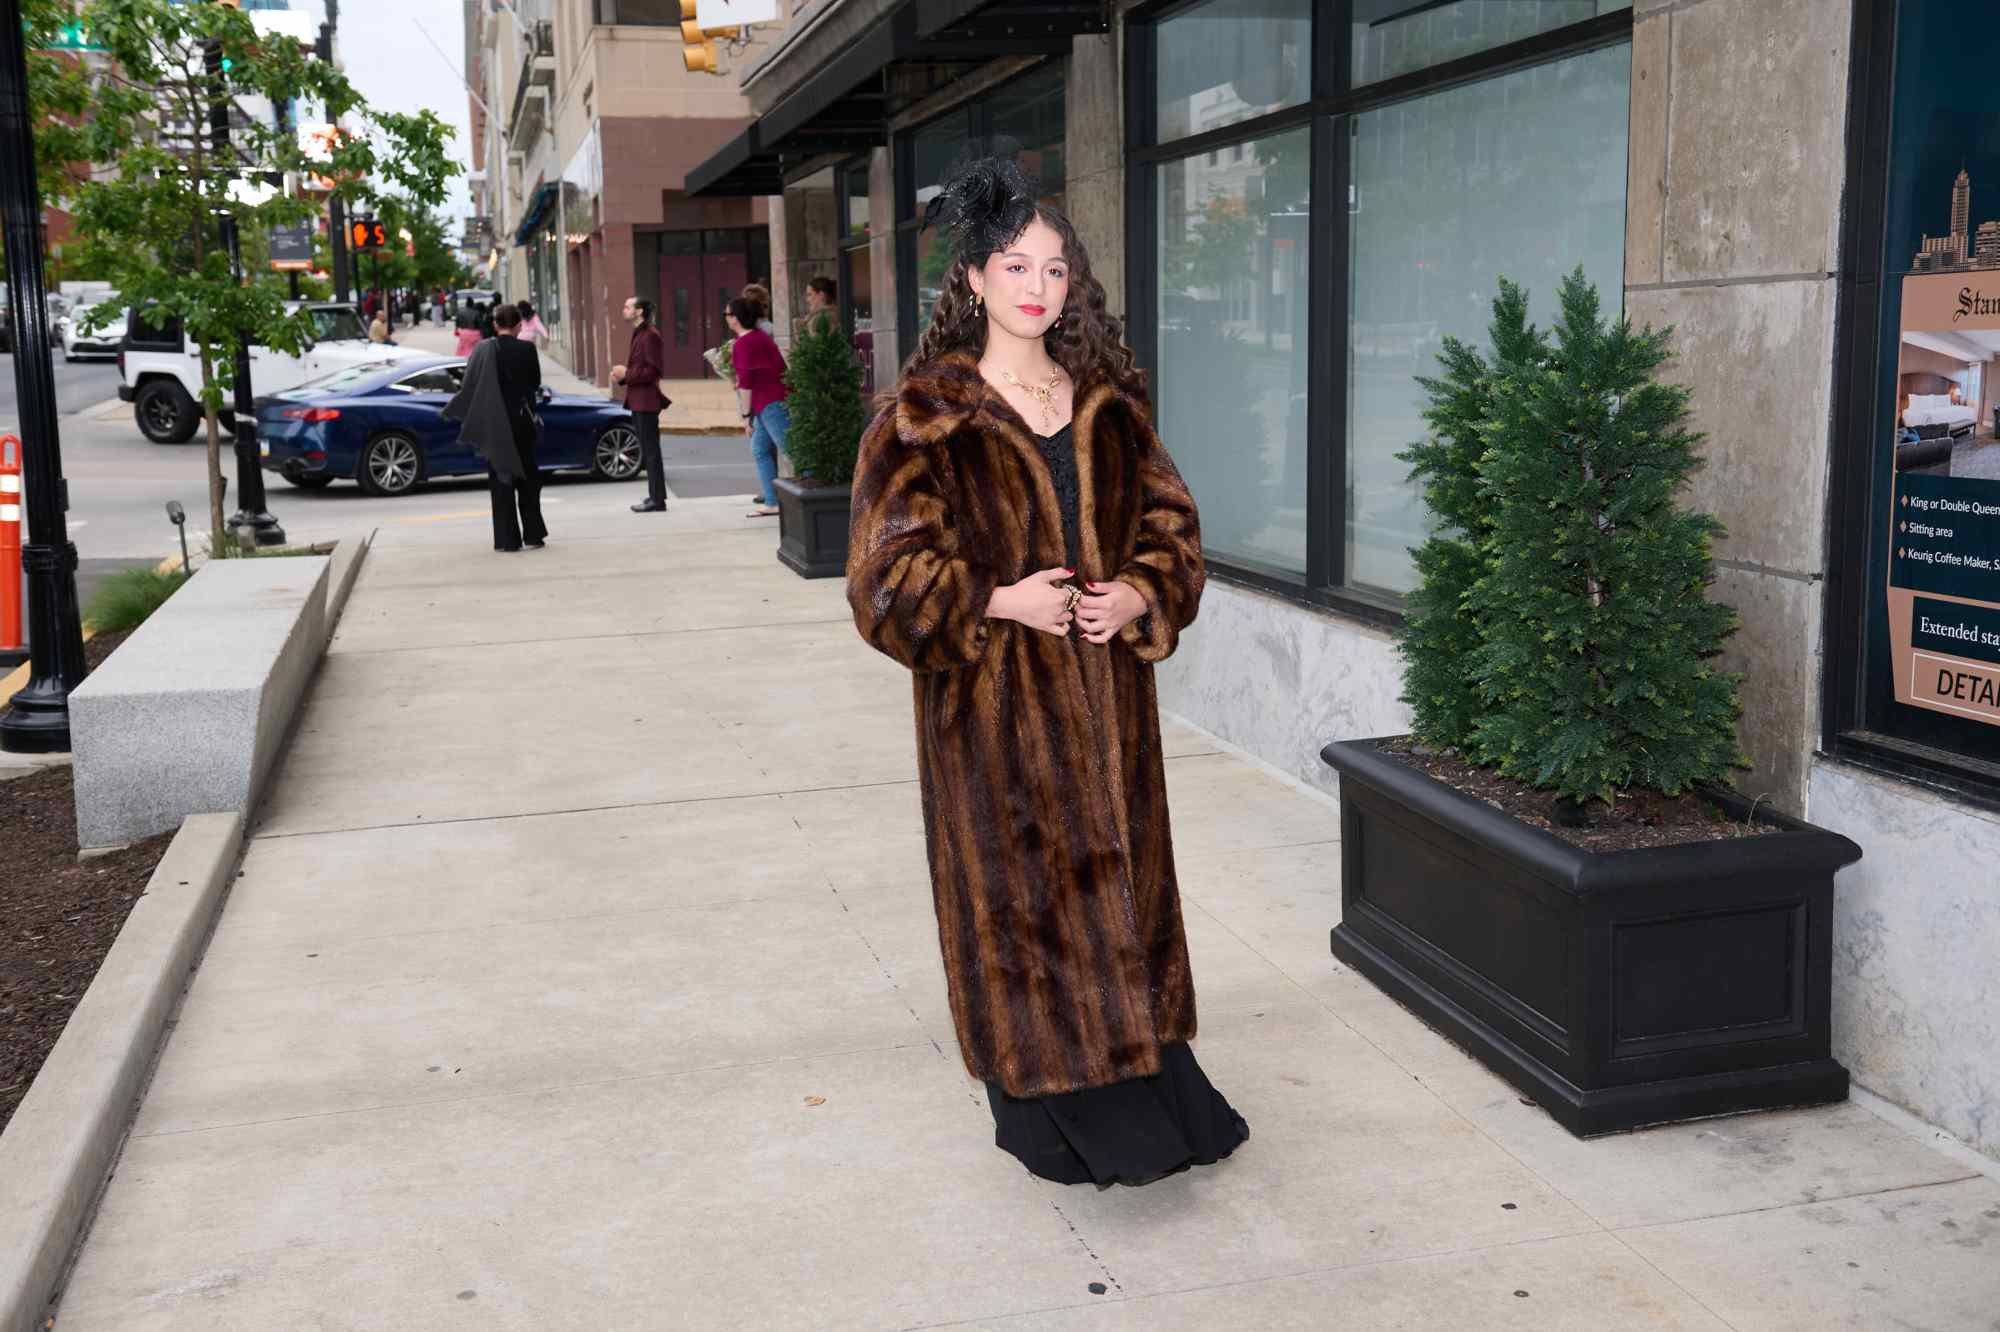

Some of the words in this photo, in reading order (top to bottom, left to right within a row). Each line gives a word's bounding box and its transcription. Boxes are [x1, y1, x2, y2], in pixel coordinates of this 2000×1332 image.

[374, 224, 385, 246] 5
[1910, 497, 1928, 511] King
[1930, 502, 1939, 510] or
[1940, 499, 1971, 512] Double
[1909, 522, 1934, 537] Sitting
[1935, 527, 1953, 538] area
[1908, 548, 1933, 564] Keurig
[1935, 551, 1961, 565] Coffee
[1963, 554, 1992, 571] Maker,
[1920, 616, 1979, 642] Extended
